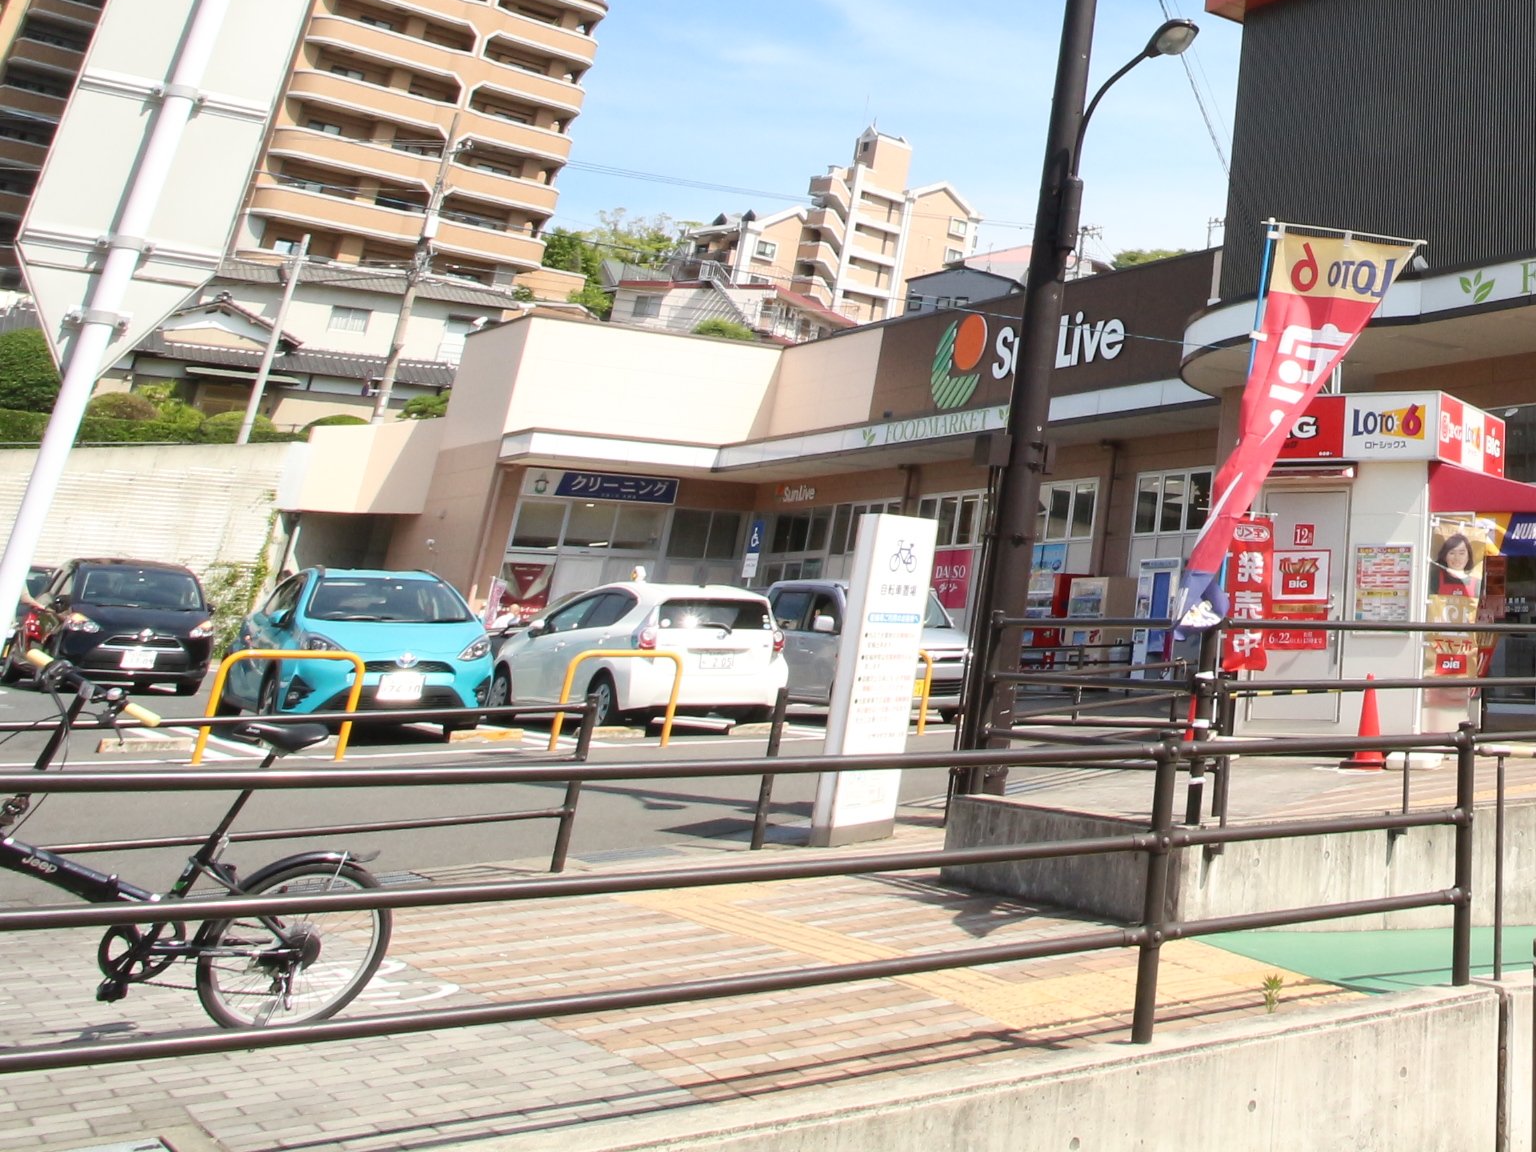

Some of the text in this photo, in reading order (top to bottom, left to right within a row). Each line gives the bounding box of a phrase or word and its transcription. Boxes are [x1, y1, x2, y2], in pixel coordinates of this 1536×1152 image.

[991, 311, 1125, 380] SLive
[884, 409, 990, 443] FOODMARKET
[1352, 408, 1395, 438] LOTO
[1401, 403, 1423, 437] 6
[1364, 440, 1407, 450] ロトシックス
[571, 474, 670, 497] クリーニング
[22, 855, 58, 873] Jeep
